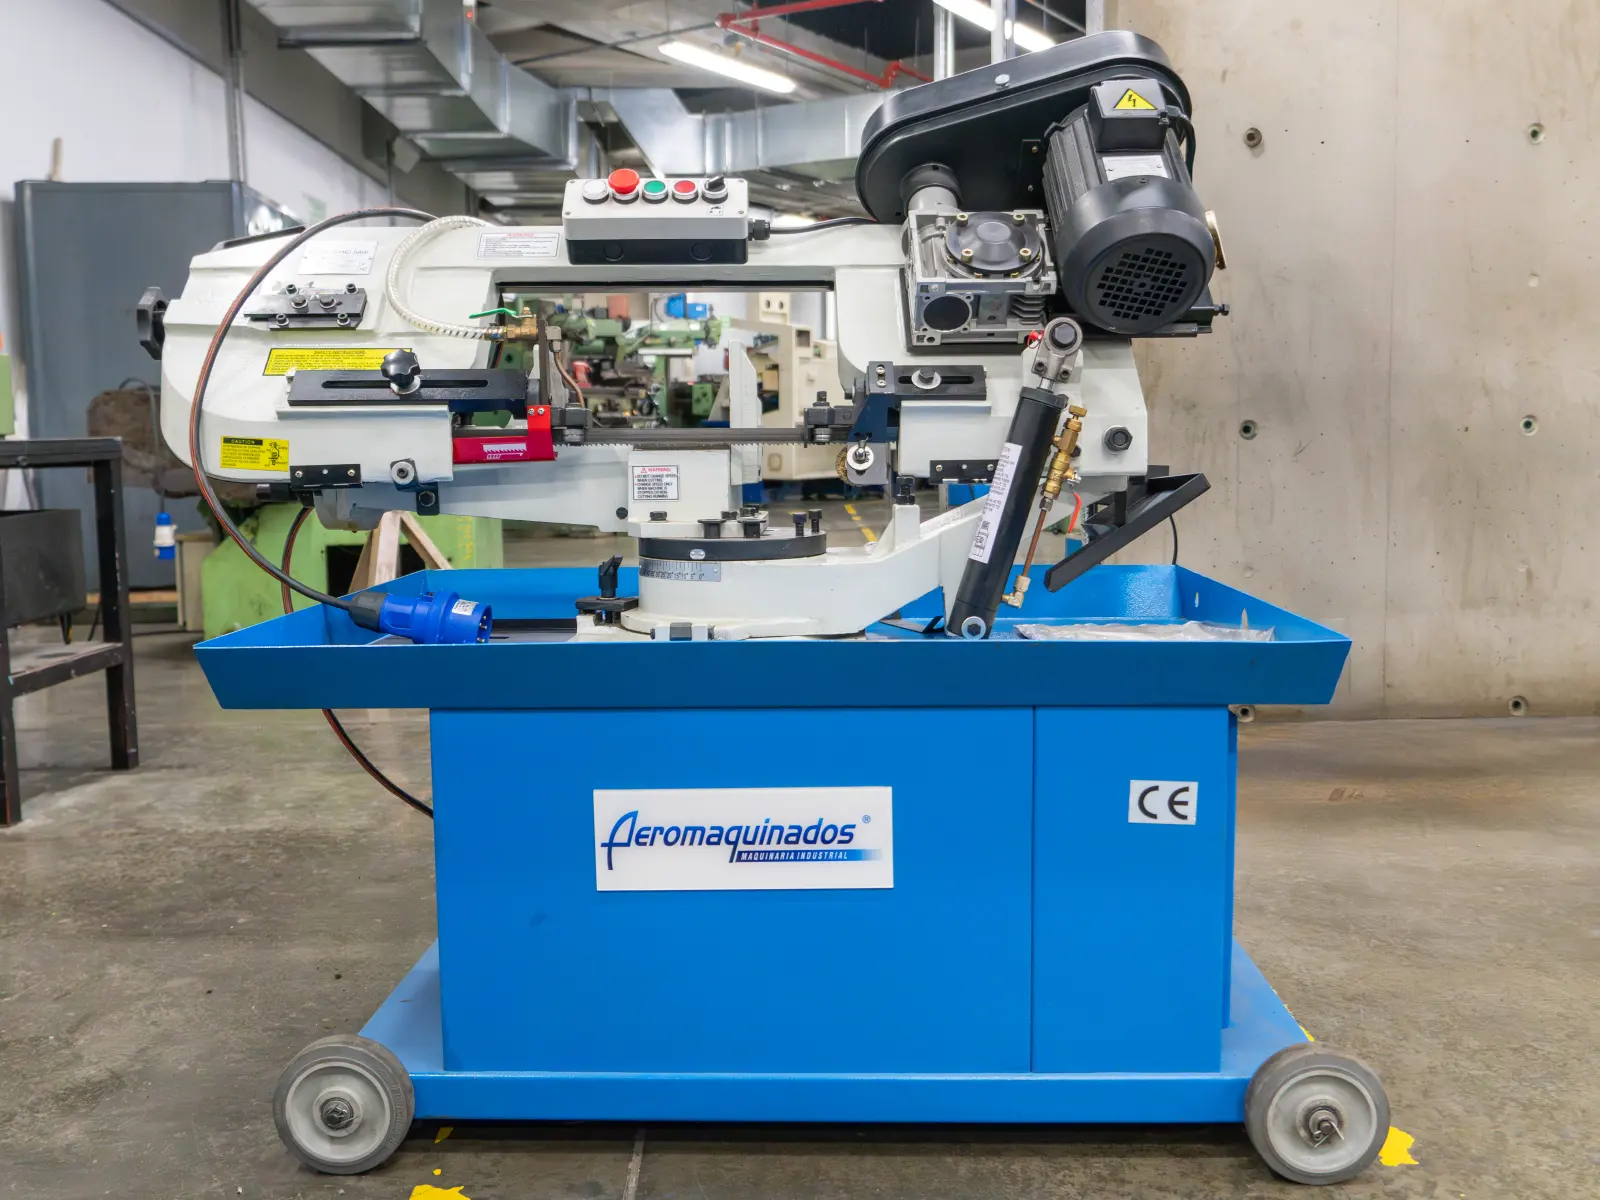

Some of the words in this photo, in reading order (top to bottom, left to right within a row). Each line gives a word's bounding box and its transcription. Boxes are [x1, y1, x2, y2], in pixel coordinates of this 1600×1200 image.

[1138, 785, 1190, 820] CE
[600, 810, 856, 870] Aeromaquinados
[740, 851, 795, 860] MAQUINARIA
[796, 851, 848, 860] INDUSTRIAL
